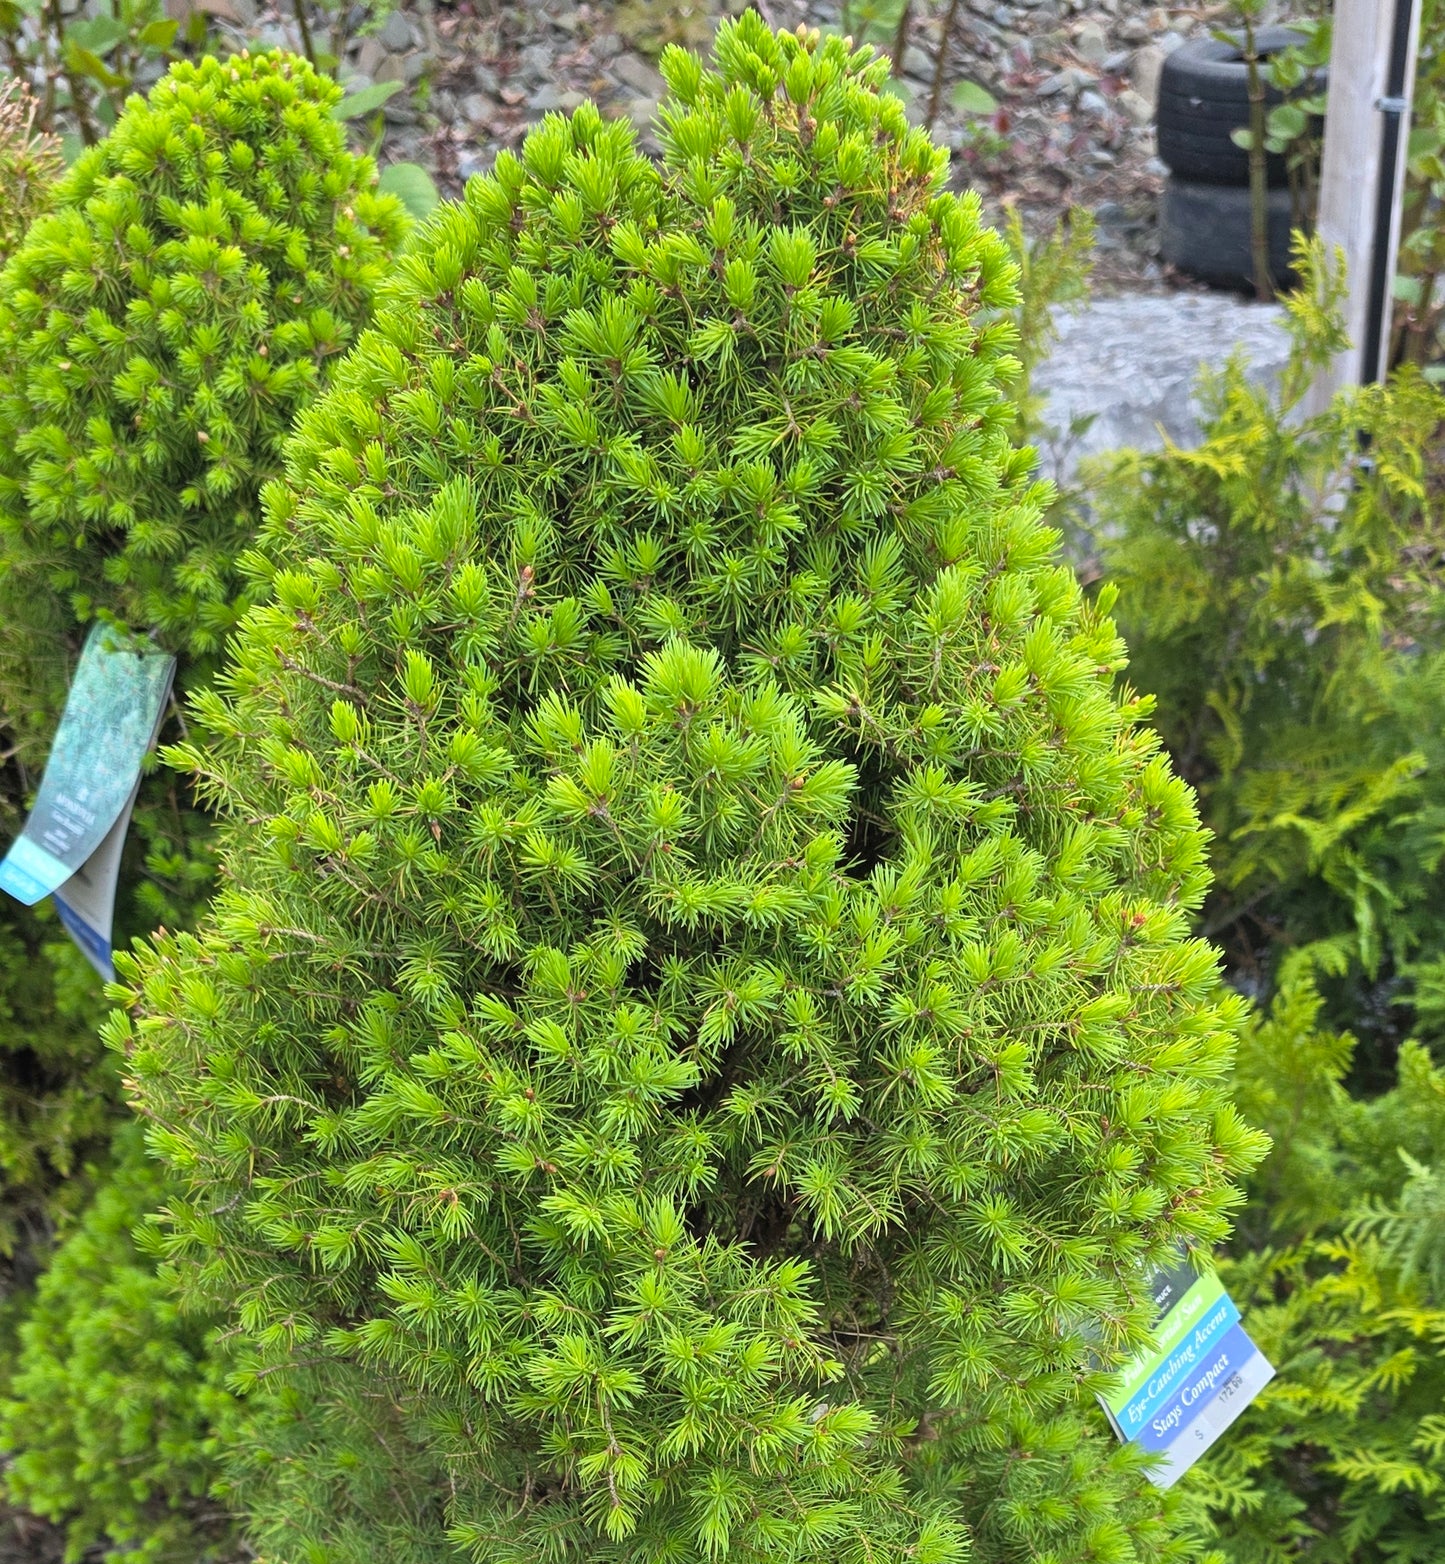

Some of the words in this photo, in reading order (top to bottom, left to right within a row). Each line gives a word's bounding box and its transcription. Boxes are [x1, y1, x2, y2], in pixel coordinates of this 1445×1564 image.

[1127, 1345, 1195, 1424] Eye-Catching
[1195, 1306, 1227, 1349] Accent
[1152, 1405, 1182, 1437] Stays
[1181, 1354, 1229, 1407] Compact
